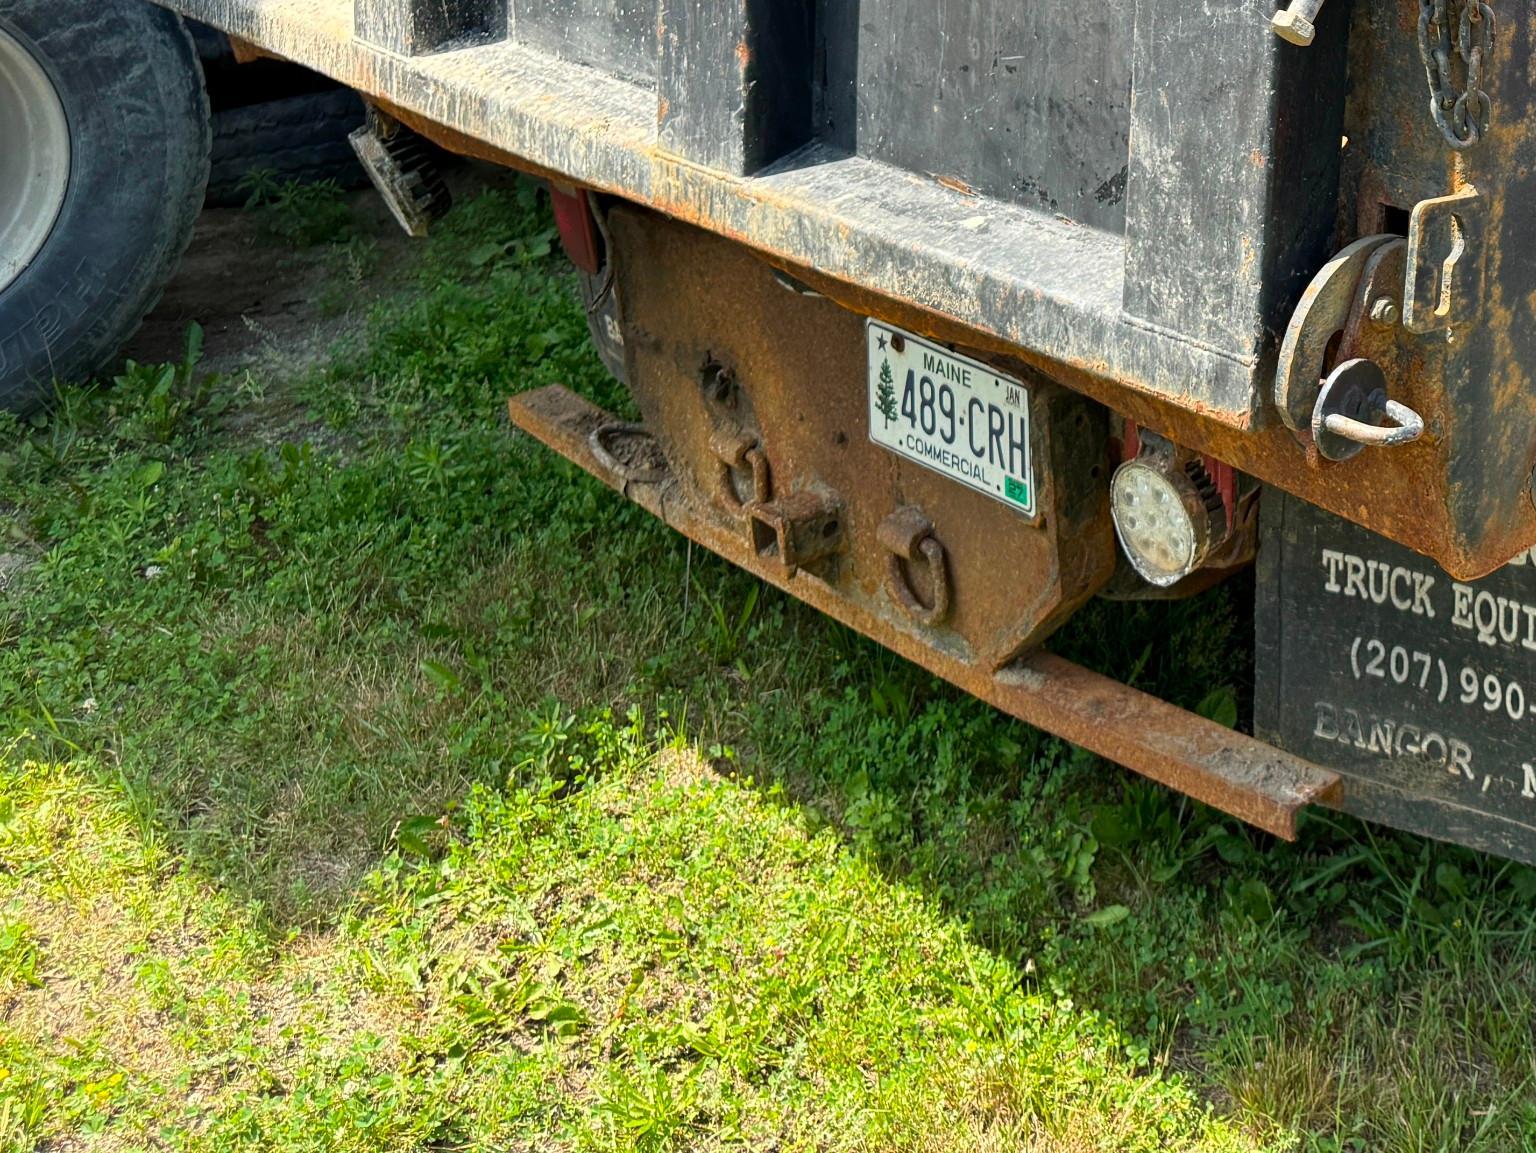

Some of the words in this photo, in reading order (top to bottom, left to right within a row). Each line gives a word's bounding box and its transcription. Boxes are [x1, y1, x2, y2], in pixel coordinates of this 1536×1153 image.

[923, 352, 972, 389] MAINE
[1006, 385, 1021, 404] JAN
[906, 434, 991, 486] COMMERCIAL
[1008, 482, 1024, 498] 27
[1322, 549, 1436, 618] TRUCK
